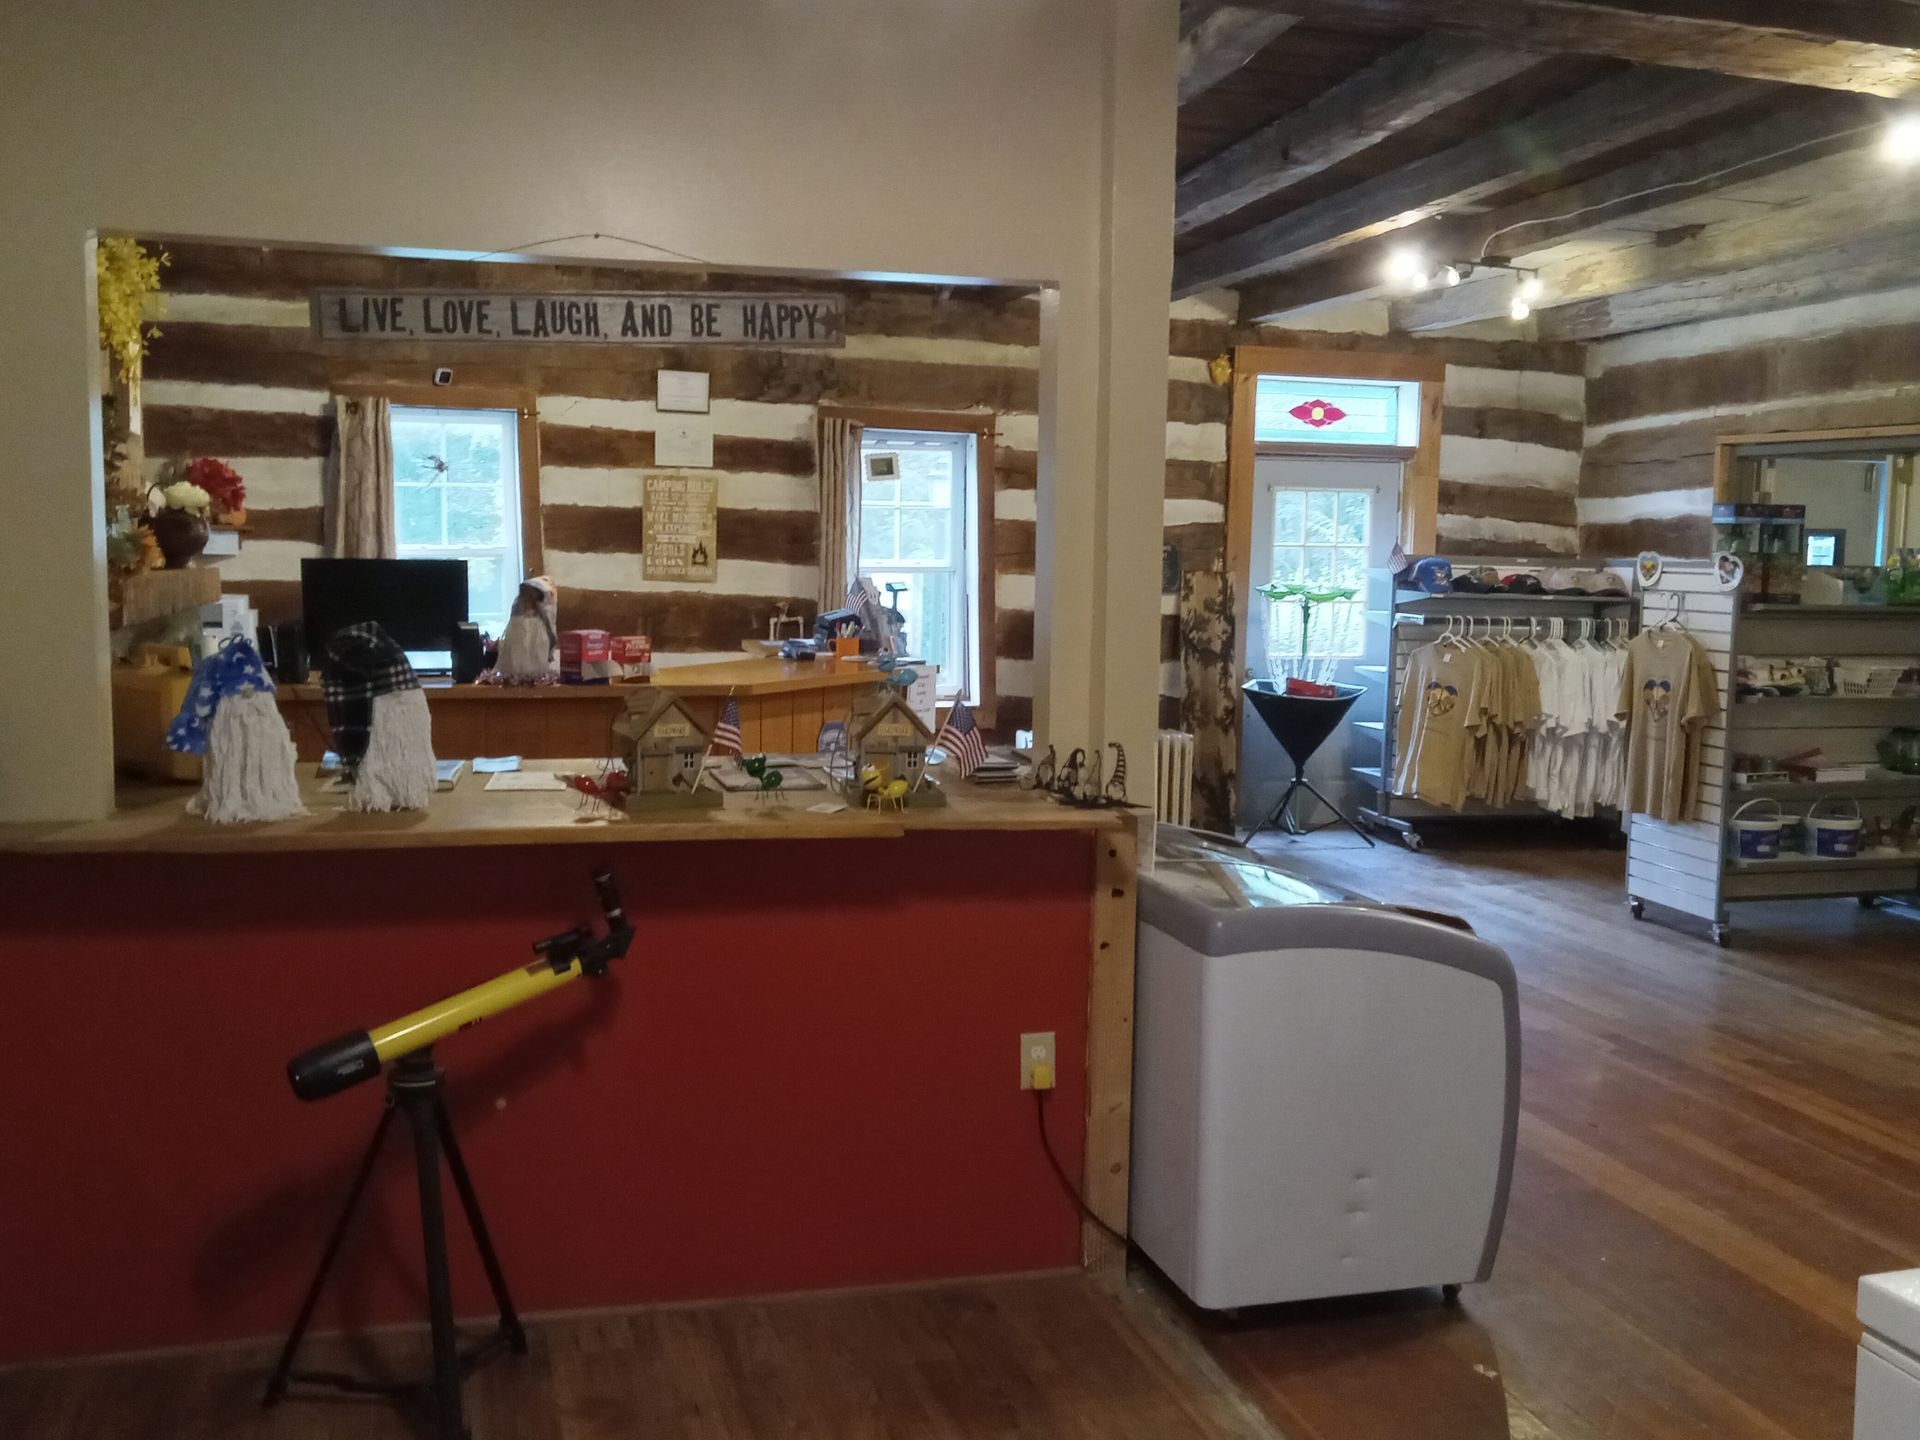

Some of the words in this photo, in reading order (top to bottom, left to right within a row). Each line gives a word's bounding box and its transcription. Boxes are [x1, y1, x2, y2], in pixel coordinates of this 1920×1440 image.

[338, 297, 414, 336] LIVE,
[422, 297, 500, 338] LOVE,
[510, 299, 609, 340] LAUGH,
[621, 300, 673, 338] AND
[690, 303, 722, 338] BE
[742, 301, 819, 341] HAPPY
[646, 479, 686, 492] CAMPING
